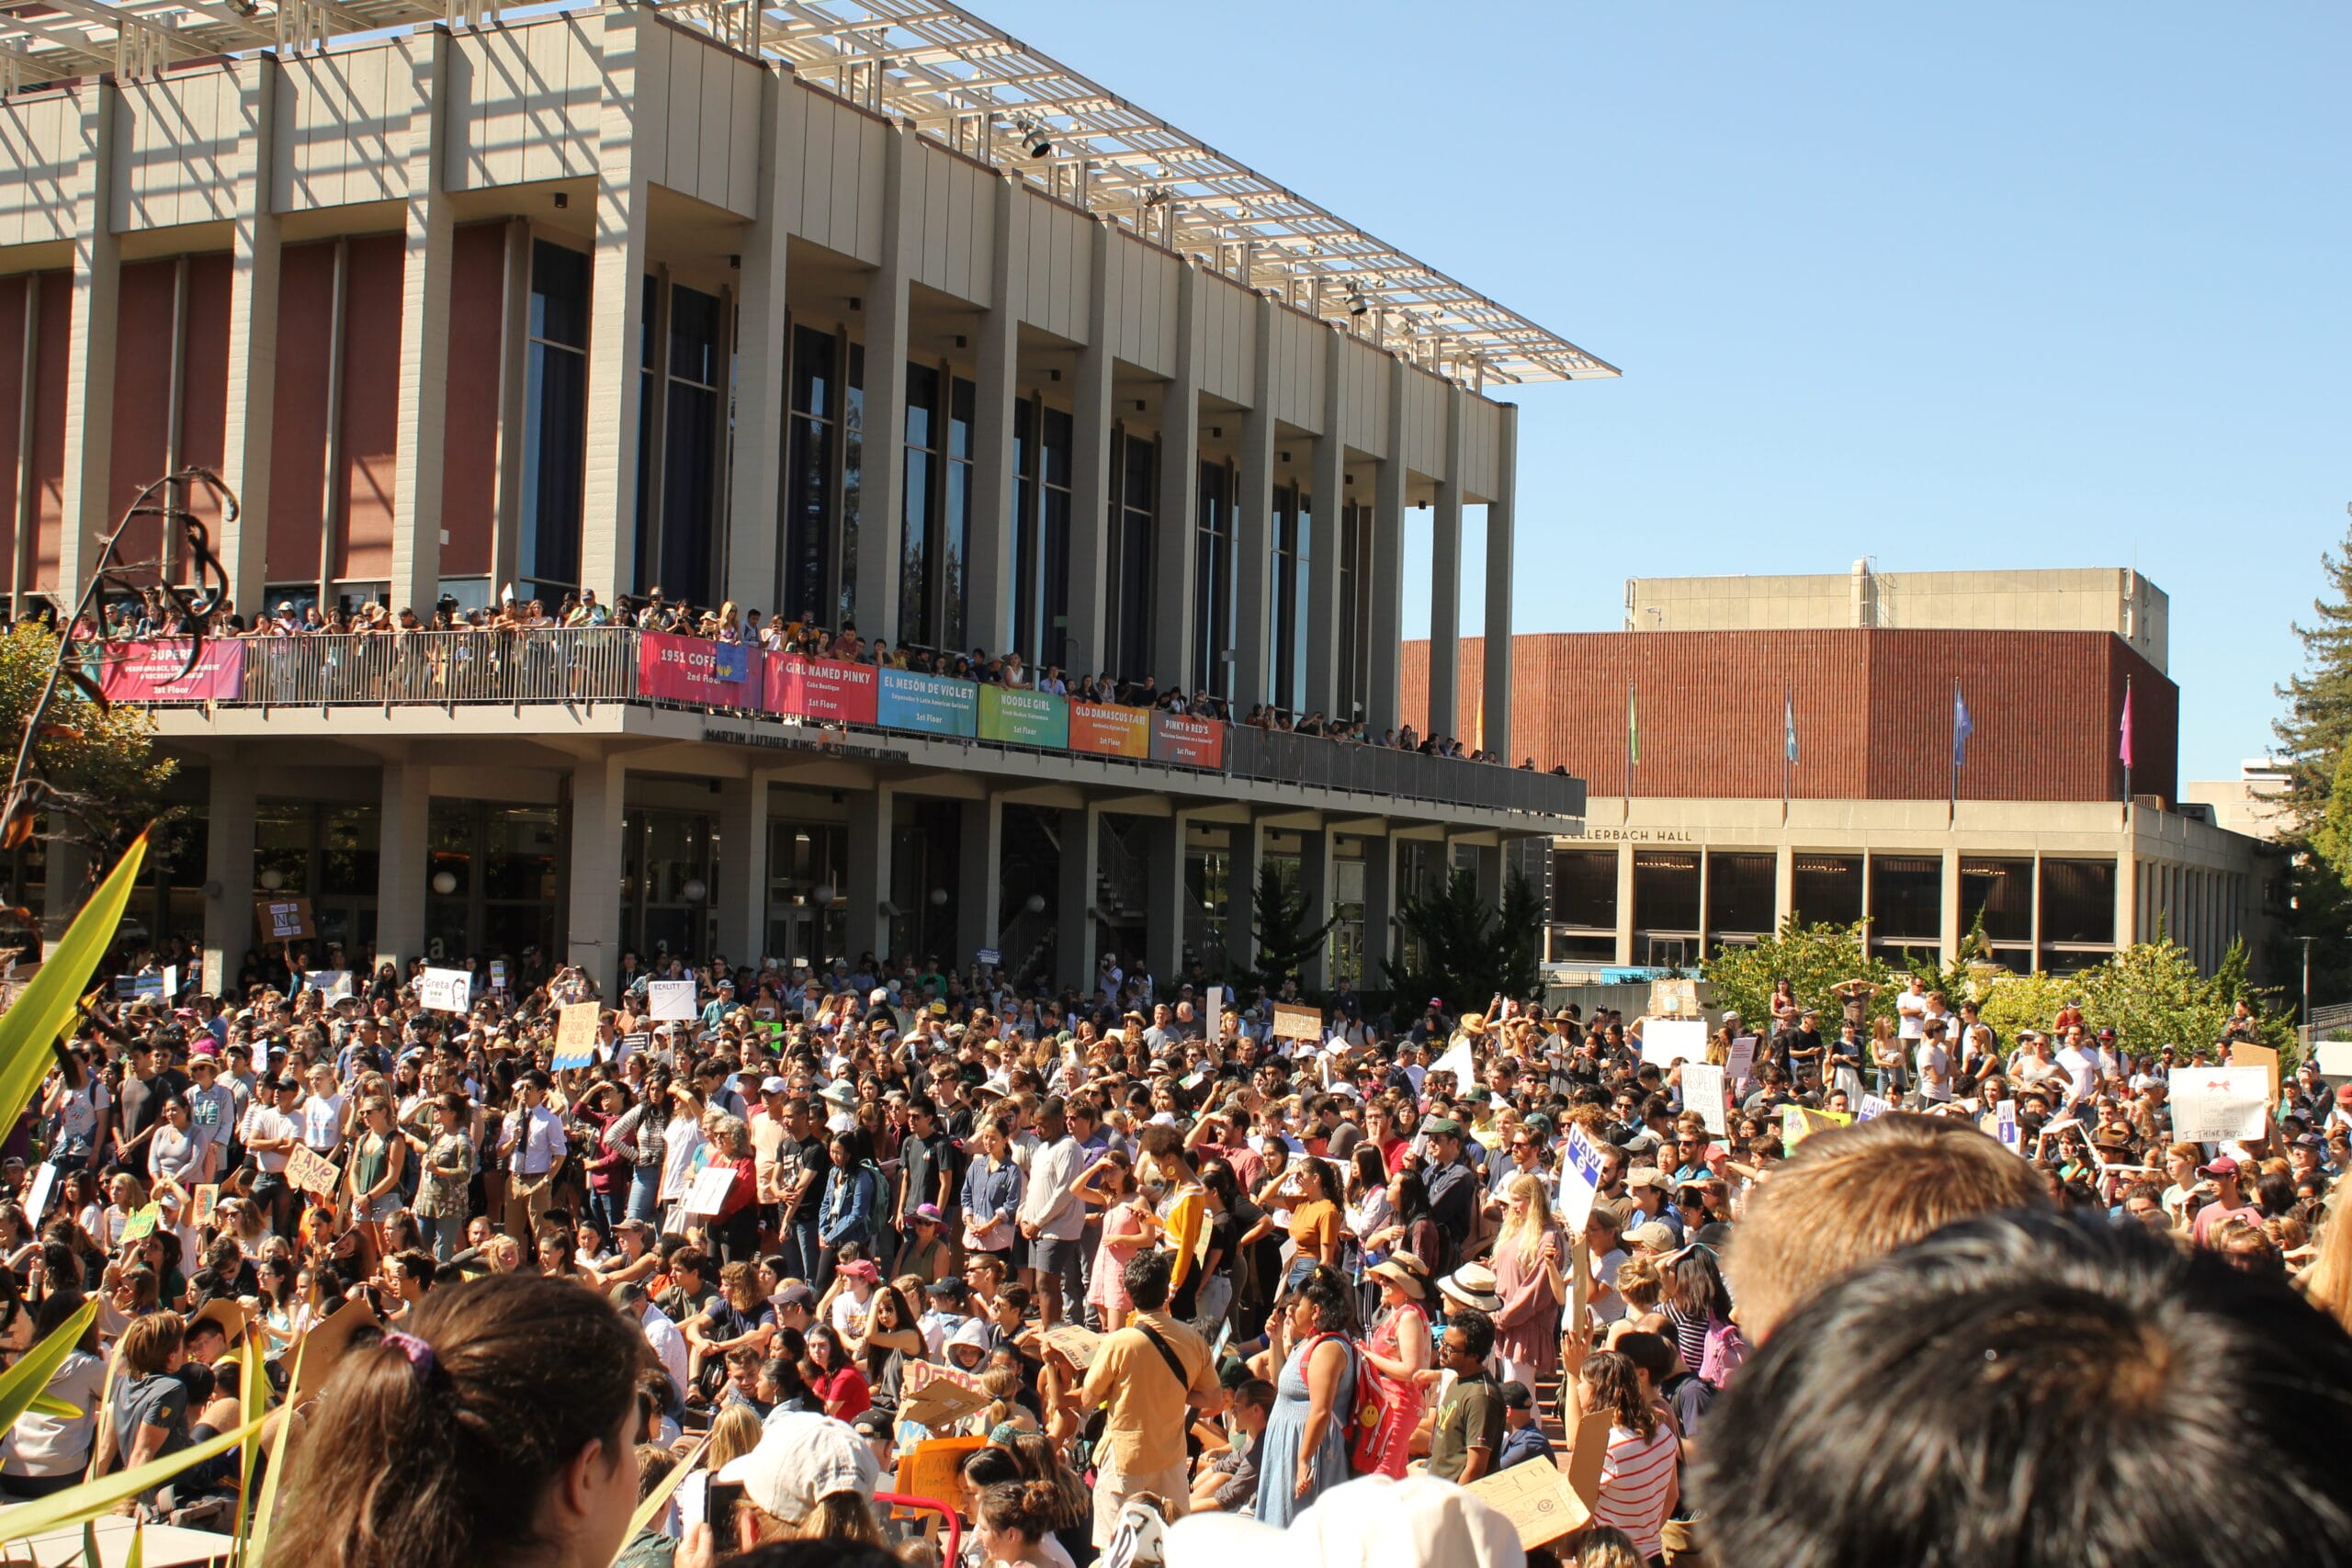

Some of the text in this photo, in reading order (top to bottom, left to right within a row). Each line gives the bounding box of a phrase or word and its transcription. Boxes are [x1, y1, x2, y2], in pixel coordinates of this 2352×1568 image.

[662, 649, 717, 667] 1951 COFF
[687, 671, 701, 682] 2nd
[778, 660, 871, 684] A GIRL NAMED PINKY
[167, 685, 189, 694] Floor
[807, 681, 840, 692] Cake Boutique
[885, 675, 894, 687] EL
[896, 678, 925, 693] MESÓN
[928, 682, 939, 694] DE
[809, 698, 837, 709] 1st Floor
[1001, 694, 1050, 711] NOODLE GIRL
[917, 713, 943, 724] 1st Floor
[1076, 705, 1090, 716] OLD
[1091, 708, 1127, 723] DAMASCUS
[1023, 727, 1036, 736] Floor
[1165, 719, 1209, 735] PINKY & RED'S
[706, 728, 746, 743] MARTIN
[750, 734, 788, 749] LUTHER
[793, 739, 817, 751] KING
[834, 744, 876, 759] STUDENT
[879, 749, 910, 763] UNION
[1107, 738, 1121, 747] Floor
[1177, 747, 1196, 757] 1st Floor
[1657, 831, 1691, 841] HALL
[425, 977, 449, 990] Greta
[1684, 1067, 1719, 1092] RESPECT
[1997, 1104, 2013, 1121] UAW
[2183, 1130, 2191, 1140] I
[2194, 1129, 2221, 1141] THINK
[1572, 1129, 1601, 1169] UAW
[919, 1457, 957, 1472] PLAN
